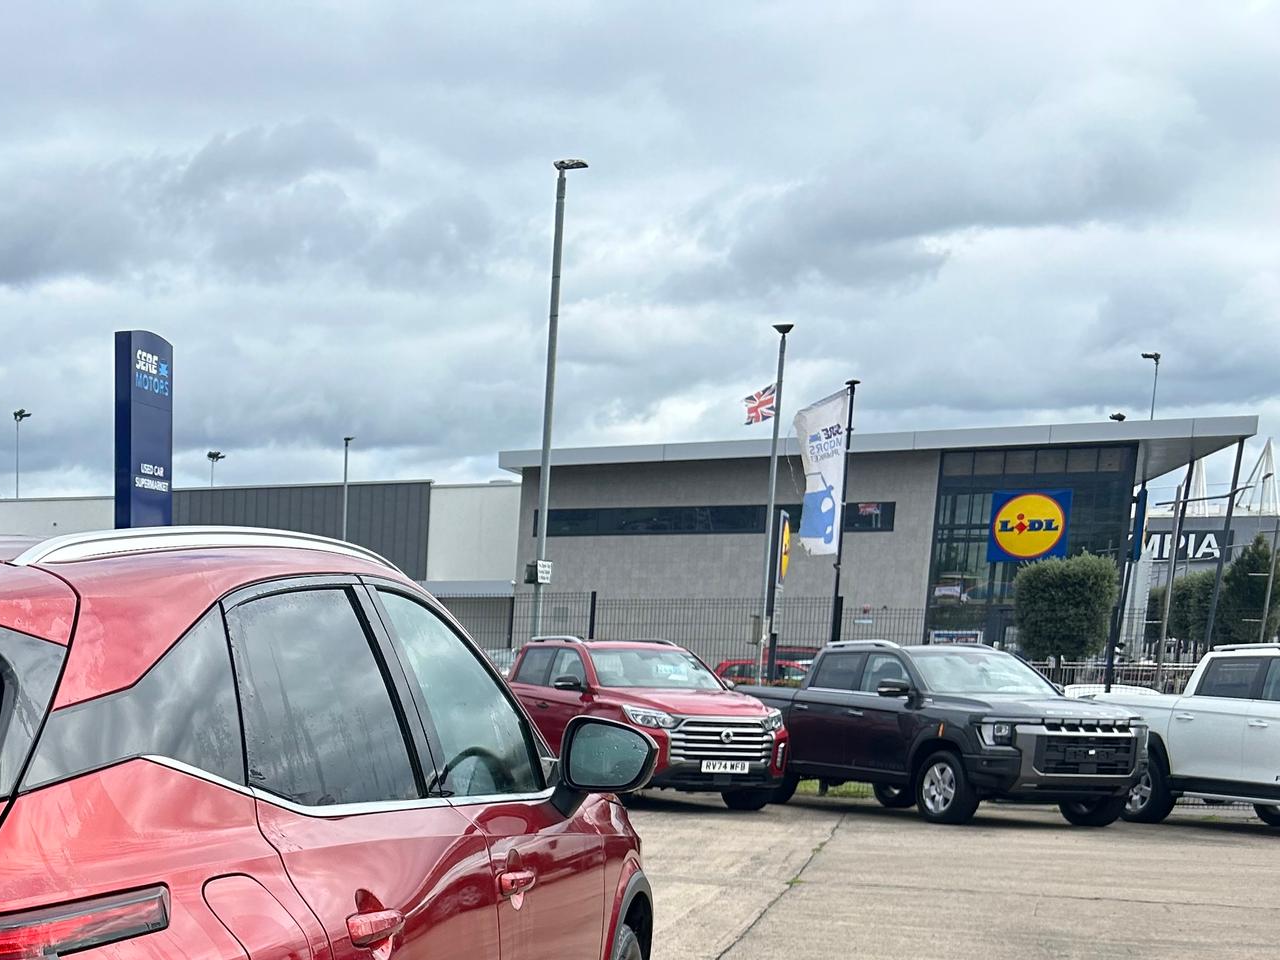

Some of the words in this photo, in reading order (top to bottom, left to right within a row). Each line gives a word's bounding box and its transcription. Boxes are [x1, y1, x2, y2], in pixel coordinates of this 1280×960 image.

[135, 371, 169, 397] MOTORS
[141, 464, 153, 474] USED
[154, 466, 164, 476] CAR
[135, 477, 168, 492] SUPERMARKET
